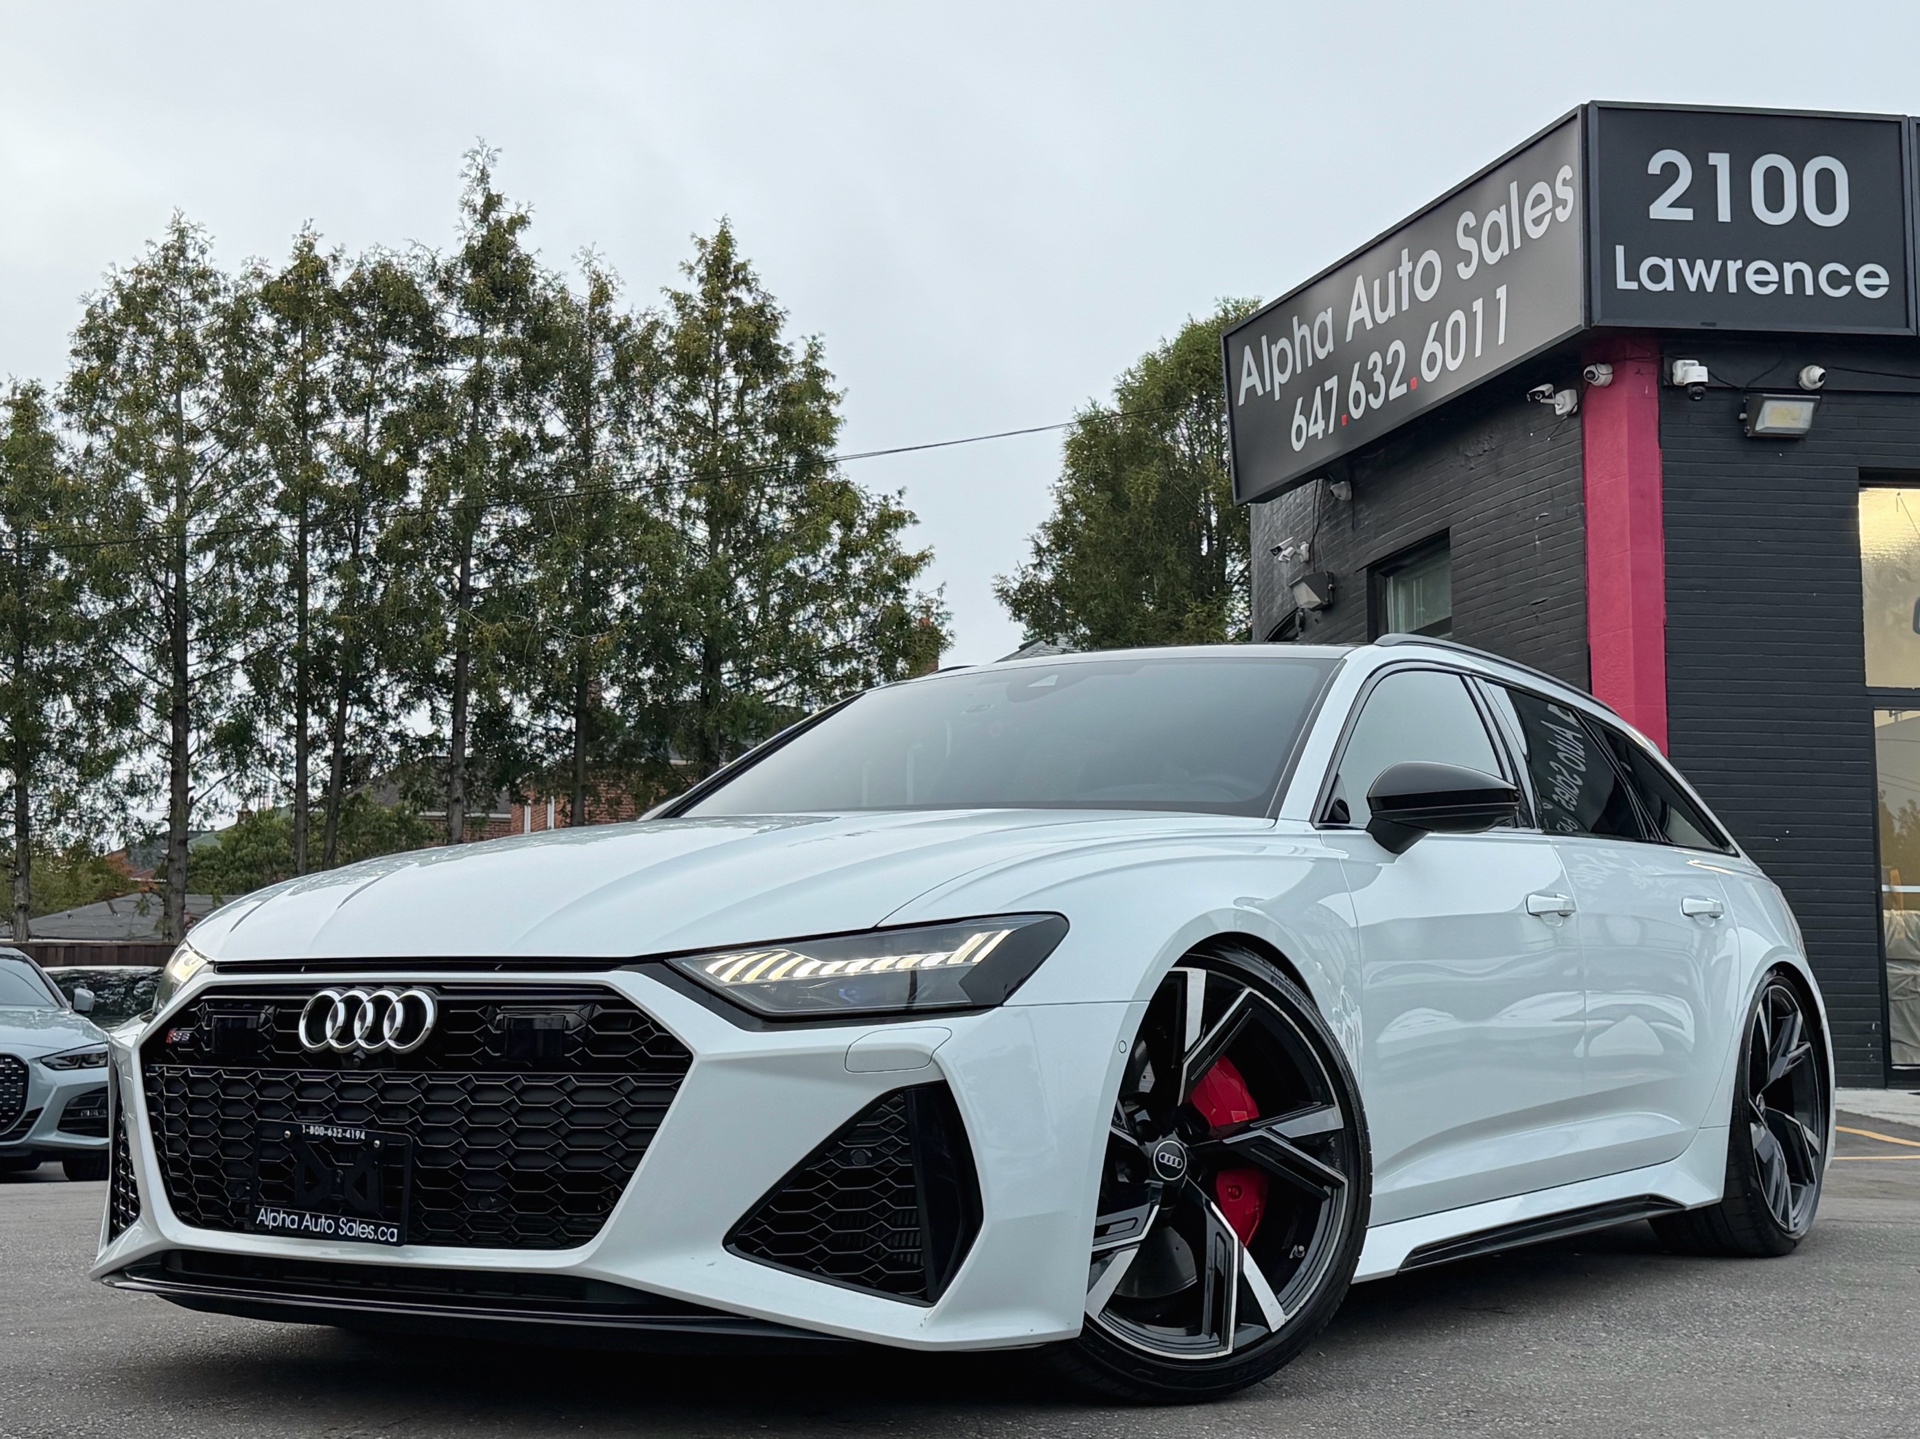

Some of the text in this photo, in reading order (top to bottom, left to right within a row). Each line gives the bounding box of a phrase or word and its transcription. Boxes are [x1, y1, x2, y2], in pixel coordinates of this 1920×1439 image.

[1647, 148, 1850, 227] 2100
[1238, 165, 1574, 406] Alpha Auto Sales
[1615, 245, 1890, 299] Lawrence
[1290, 284, 1507, 452] 647.632.6011
[301, 1124, 366, 1140] 1-800-632-4194
[256, 1208, 398, 1242] Alpha Auto Sales.ca
